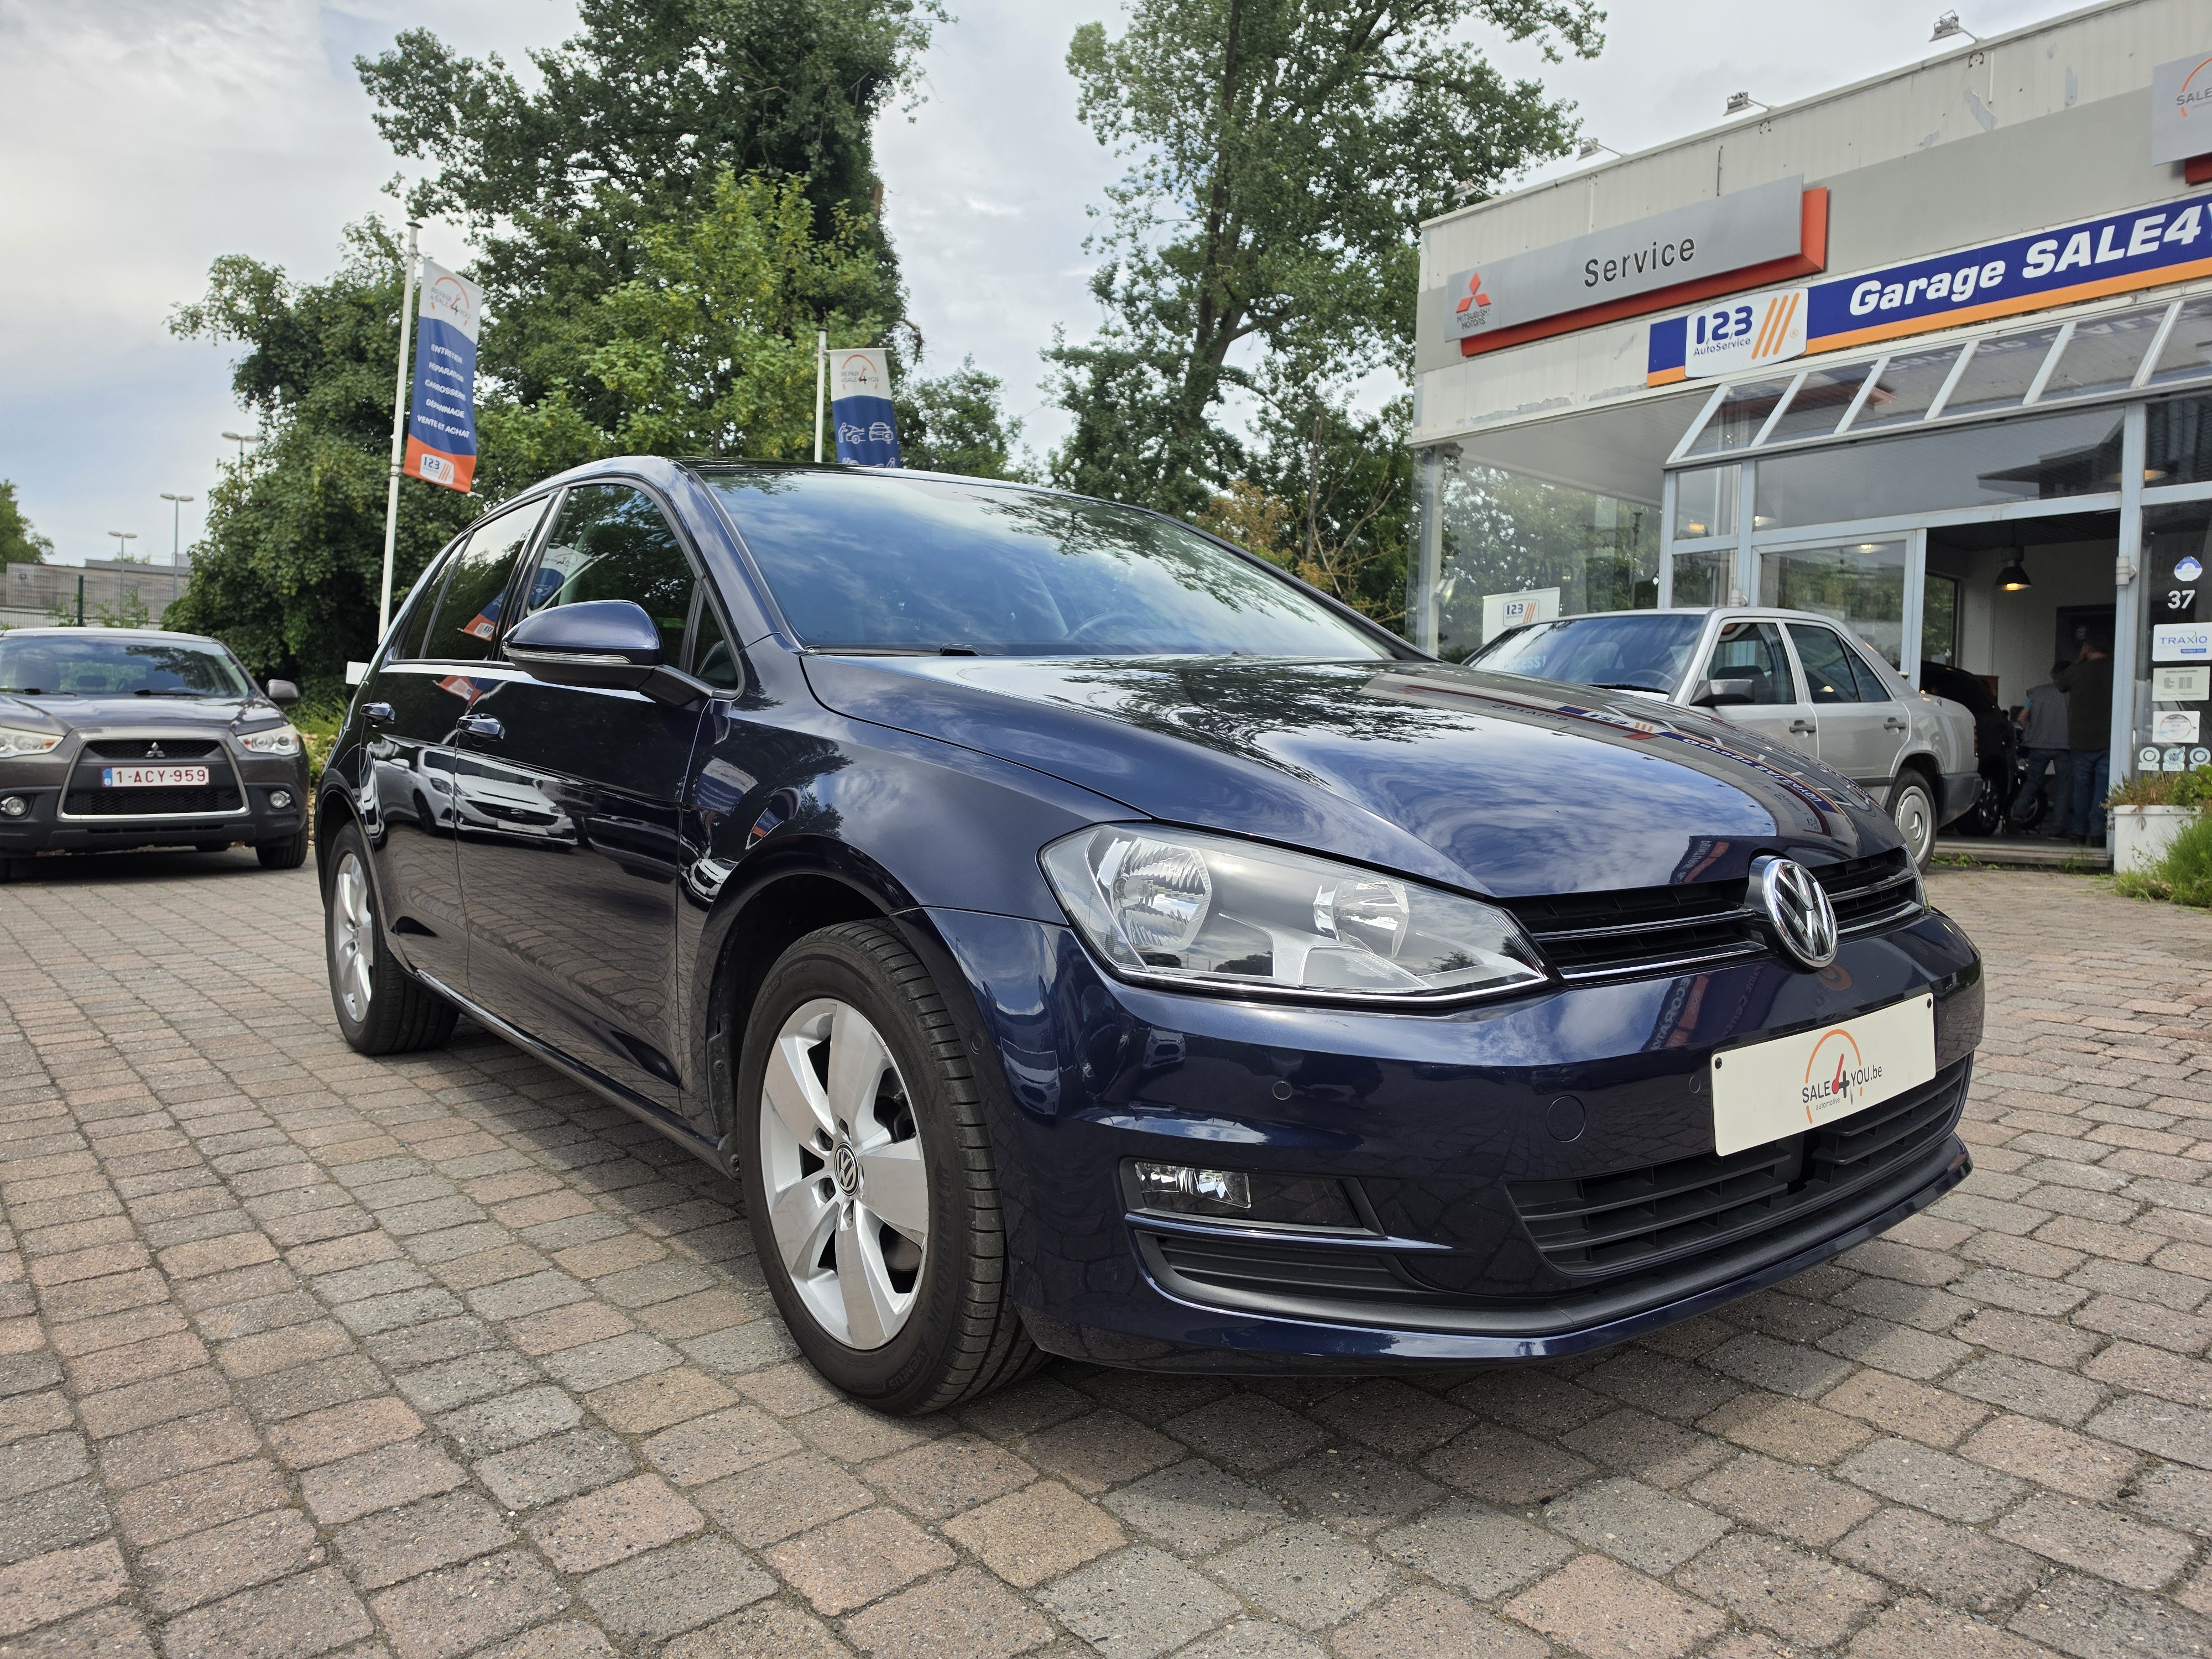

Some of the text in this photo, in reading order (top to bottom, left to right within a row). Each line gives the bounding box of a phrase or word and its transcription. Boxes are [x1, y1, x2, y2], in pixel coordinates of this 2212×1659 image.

[1583, 237, 1695, 288] Service
[1850, 202, 2212, 316] Garage SALE4
[1457, 307, 1490, 324] MITSUBISHI
[1461, 316, 1486, 330] MOTORS
[431, 343, 463, 364] ENTRETIEN
[1693, 338, 1751, 357] AutoService
[424, 379, 466, 401] CARROSSERIE
[426, 398, 465, 419] DÉPANNAGE
[417, 414, 470, 438] VENTE ET ACHAT
[2168, 589, 2195, 609] 37
[2158, 635, 2208, 645] TRAXIO
[117, 769, 206, 784] 1-ACY-959
[1815, 1097, 1840, 1110] automotive
